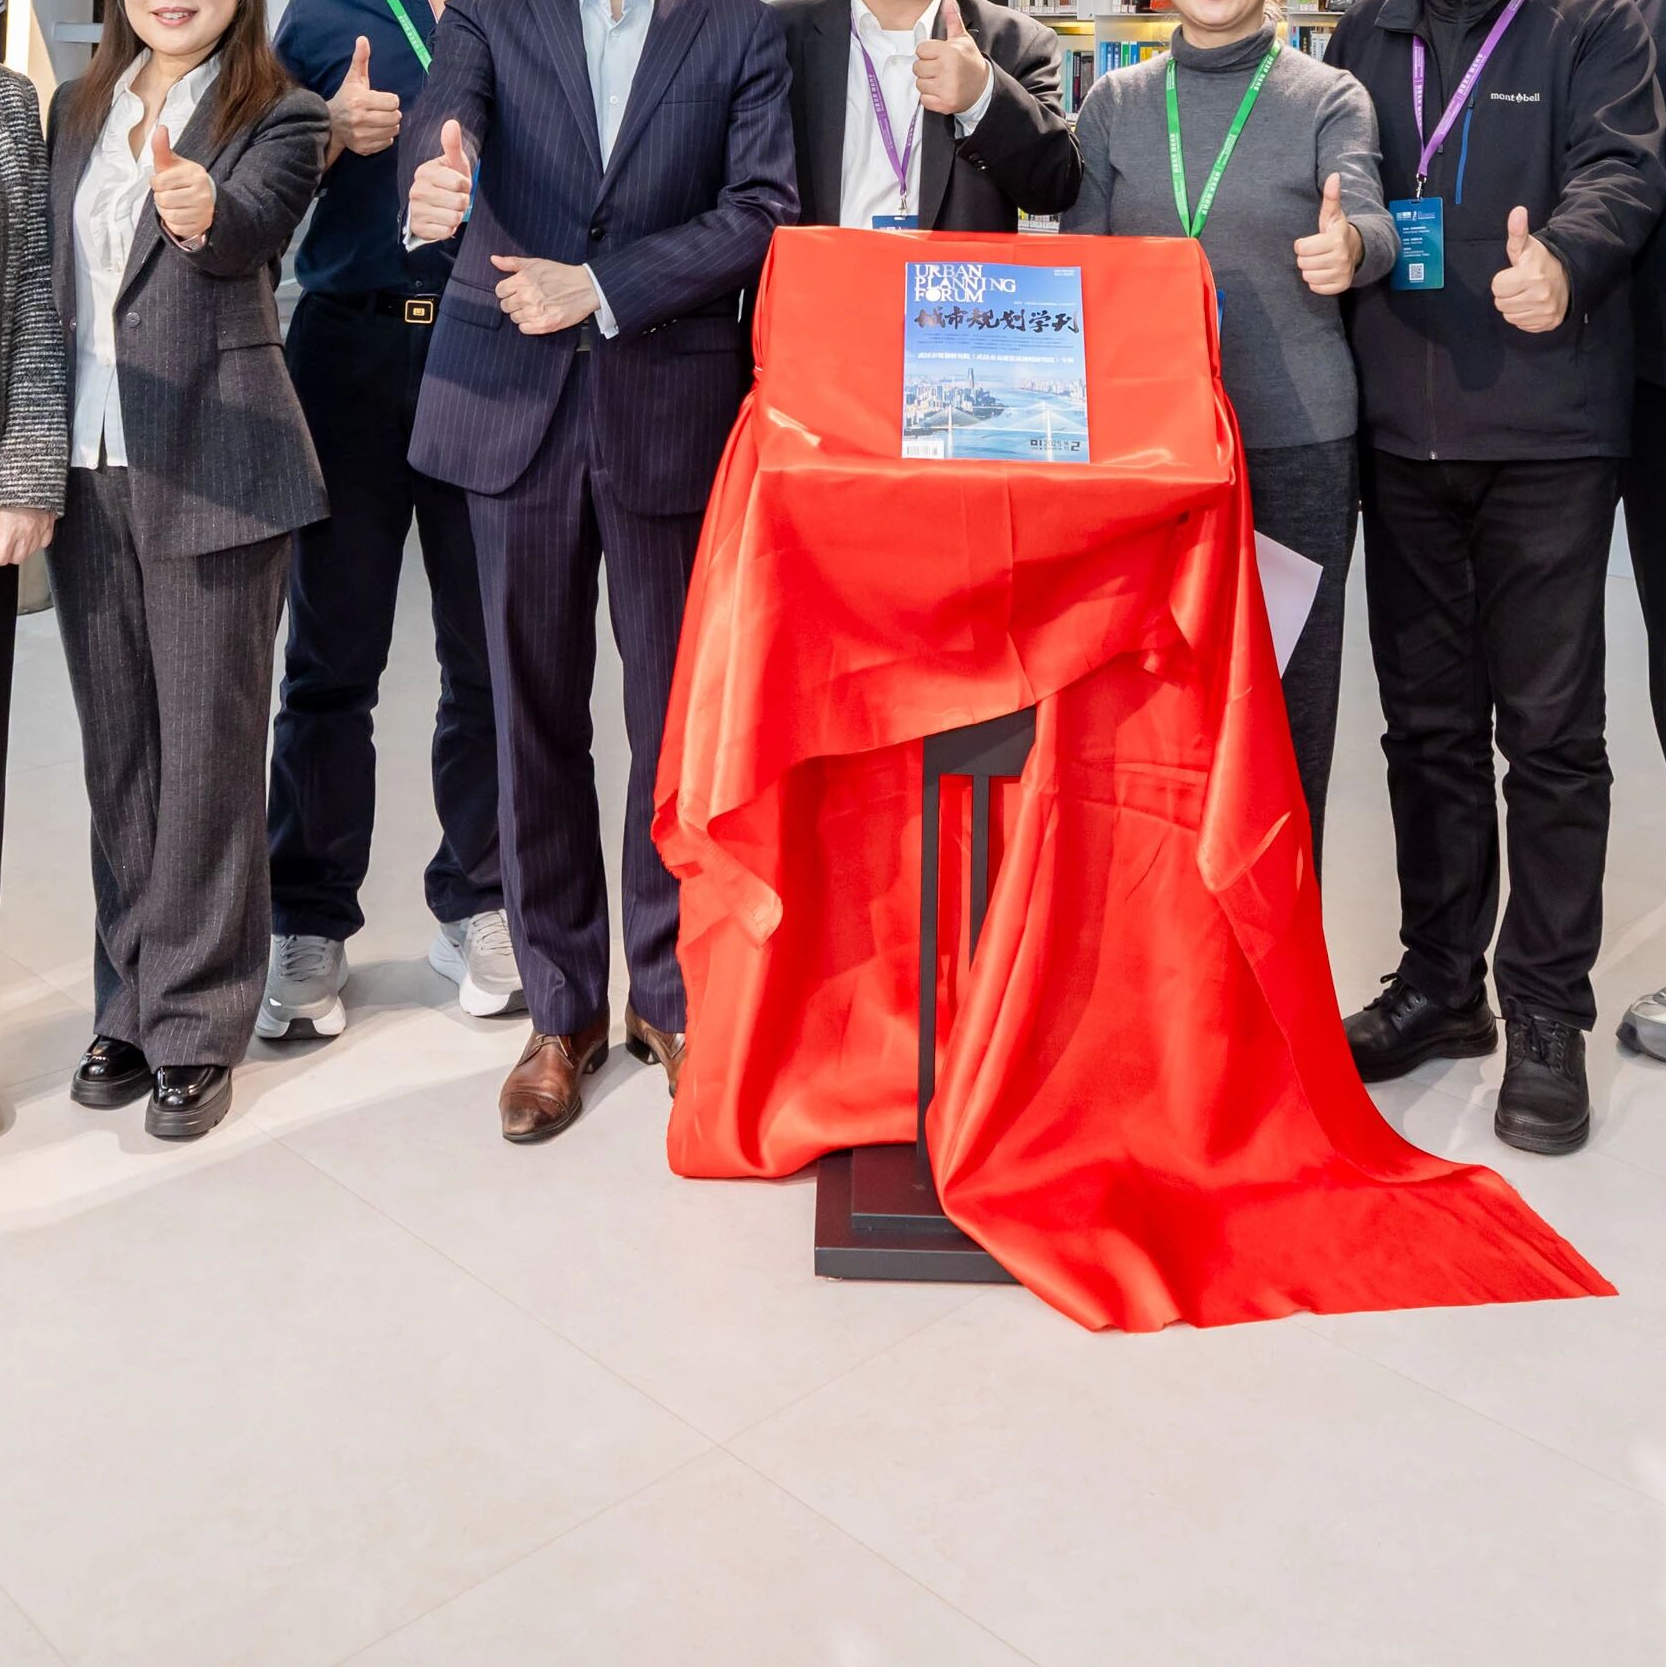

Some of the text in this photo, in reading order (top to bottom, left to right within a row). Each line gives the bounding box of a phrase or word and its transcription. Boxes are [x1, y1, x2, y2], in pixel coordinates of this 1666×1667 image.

[914, 264, 983, 279] URBAN
[914, 276, 1016, 293] PLANNING
[913, 288, 984, 303] FORUM
[914, 305, 1080, 334] 城市规划学刊
